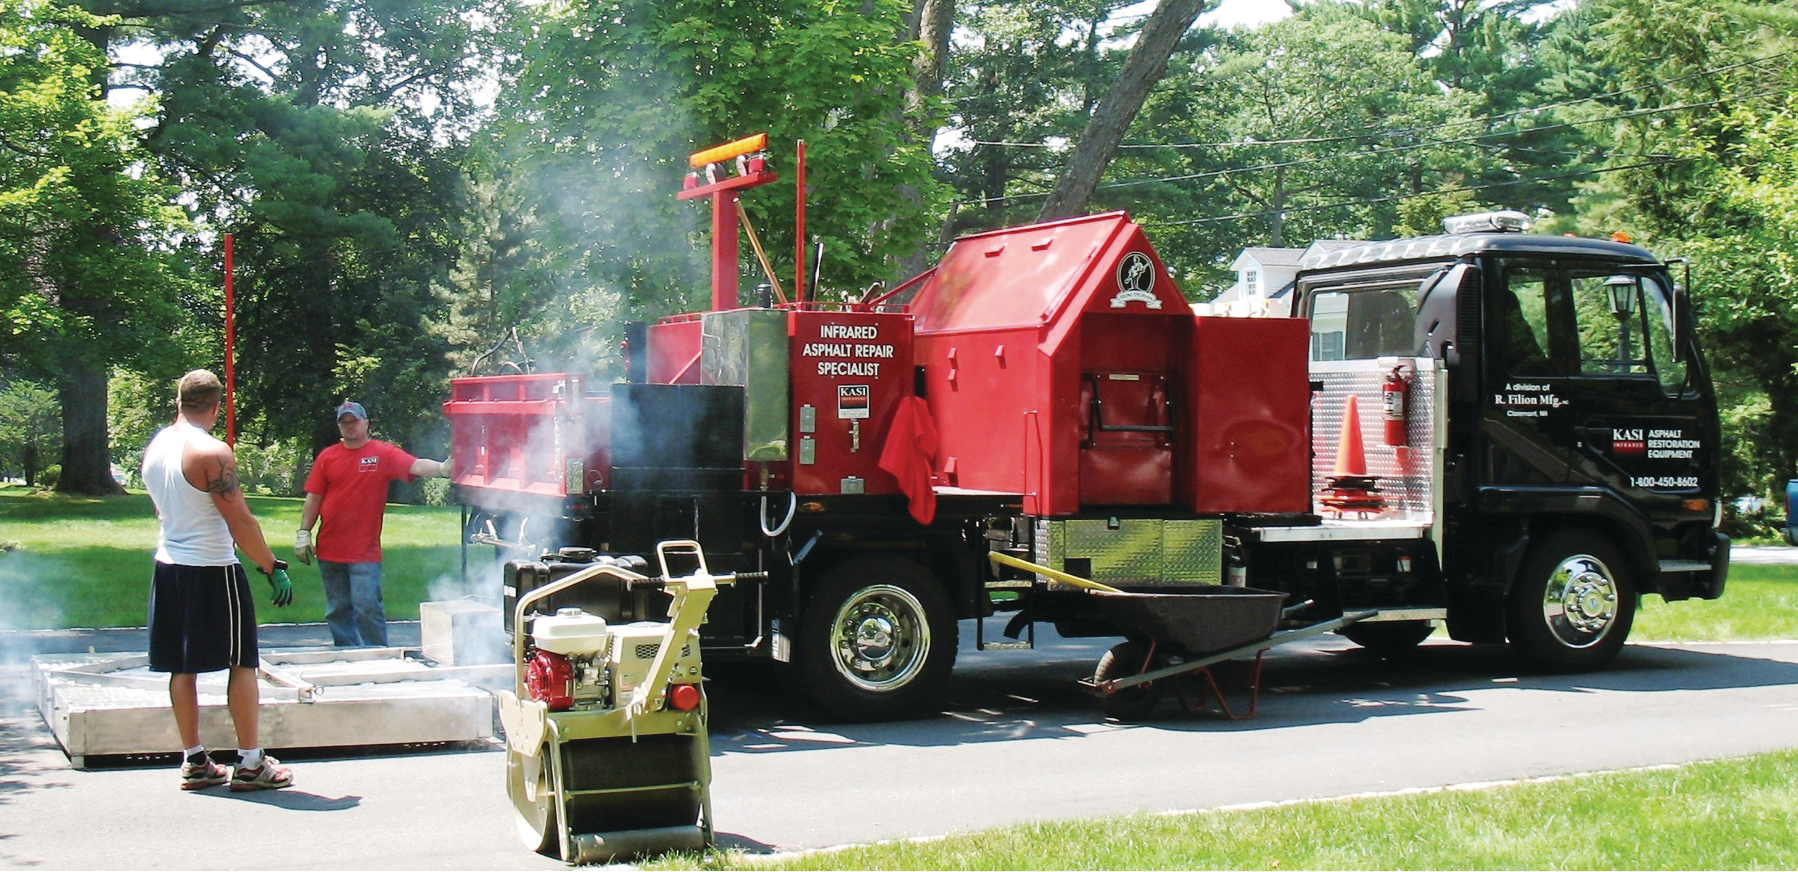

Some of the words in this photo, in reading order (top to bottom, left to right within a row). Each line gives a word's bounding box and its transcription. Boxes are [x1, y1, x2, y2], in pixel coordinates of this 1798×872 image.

[820, 325, 878, 339] INFRARED
[802, 343, 852, 357] ASPHALT
[855, 344, 894, 358] REPAIR
[817, 362, 880, 376] SPECIALIST
[840, 387, 866, 396] KASI
[1505, 383, 1512, 391] A
[1513, 383, 1541, 391] division
[1541, 383, 1551, 391] of
[1494, 394, 1506, 405] R.
[1508, 394, 1538, 405] Filion
[1612, 428, 1644, 440] KASI
[1648, 429, 1682, 439] ASPHALT
[1647, 440, 1701, 448] RESTORATION
[1647, 449, 1693, 459] EQUIPMENT
[1629, 476, 1699, 487] 1-800-450-8602
